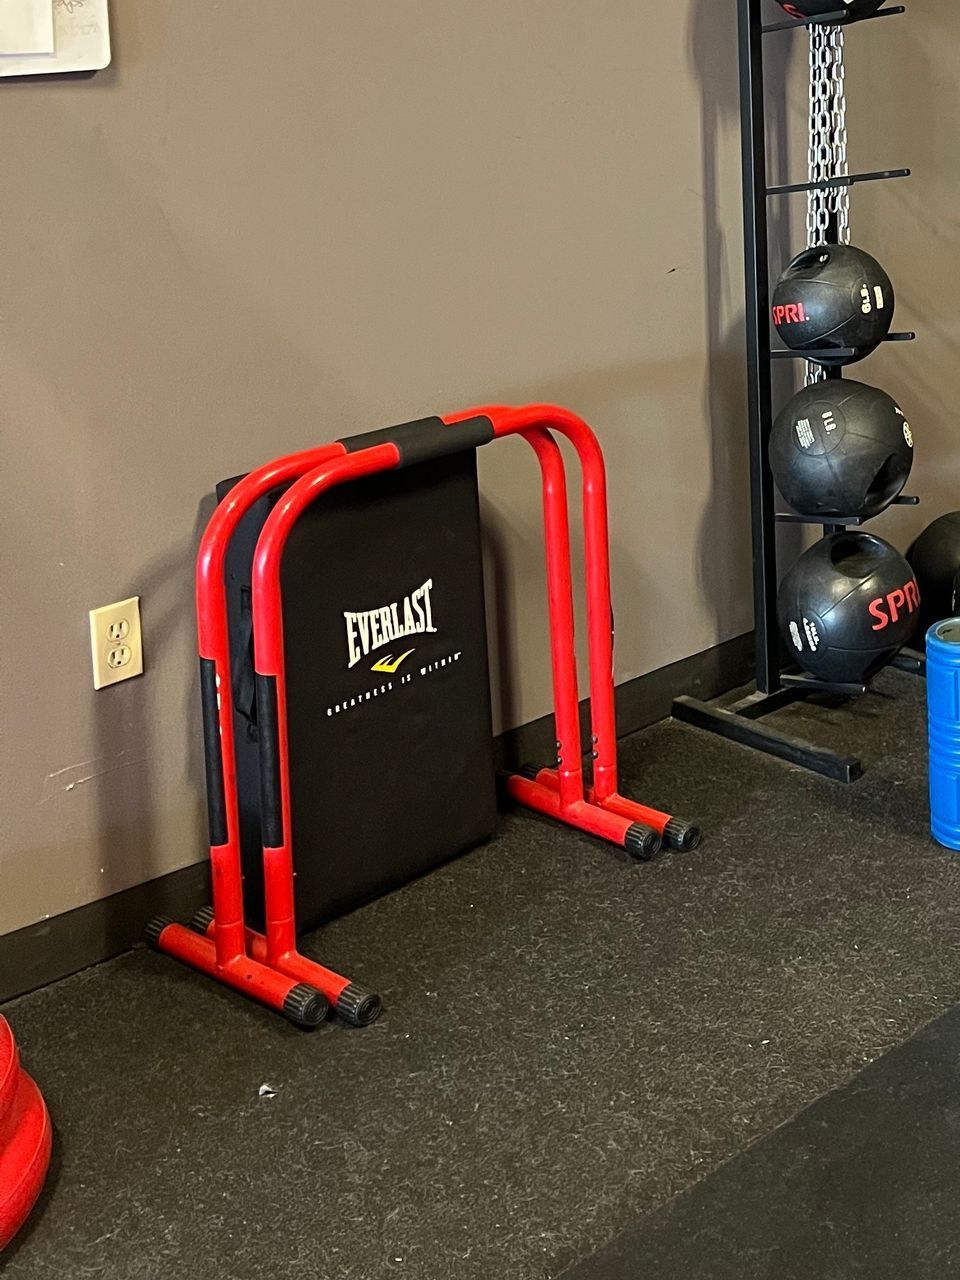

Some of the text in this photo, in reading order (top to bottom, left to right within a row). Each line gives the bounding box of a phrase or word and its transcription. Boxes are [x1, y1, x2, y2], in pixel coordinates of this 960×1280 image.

[344, 578, 437, 668] EVERLAST
[327, 682, 393, 717] GREATNESS
[401, 673, 411, 684] IS
